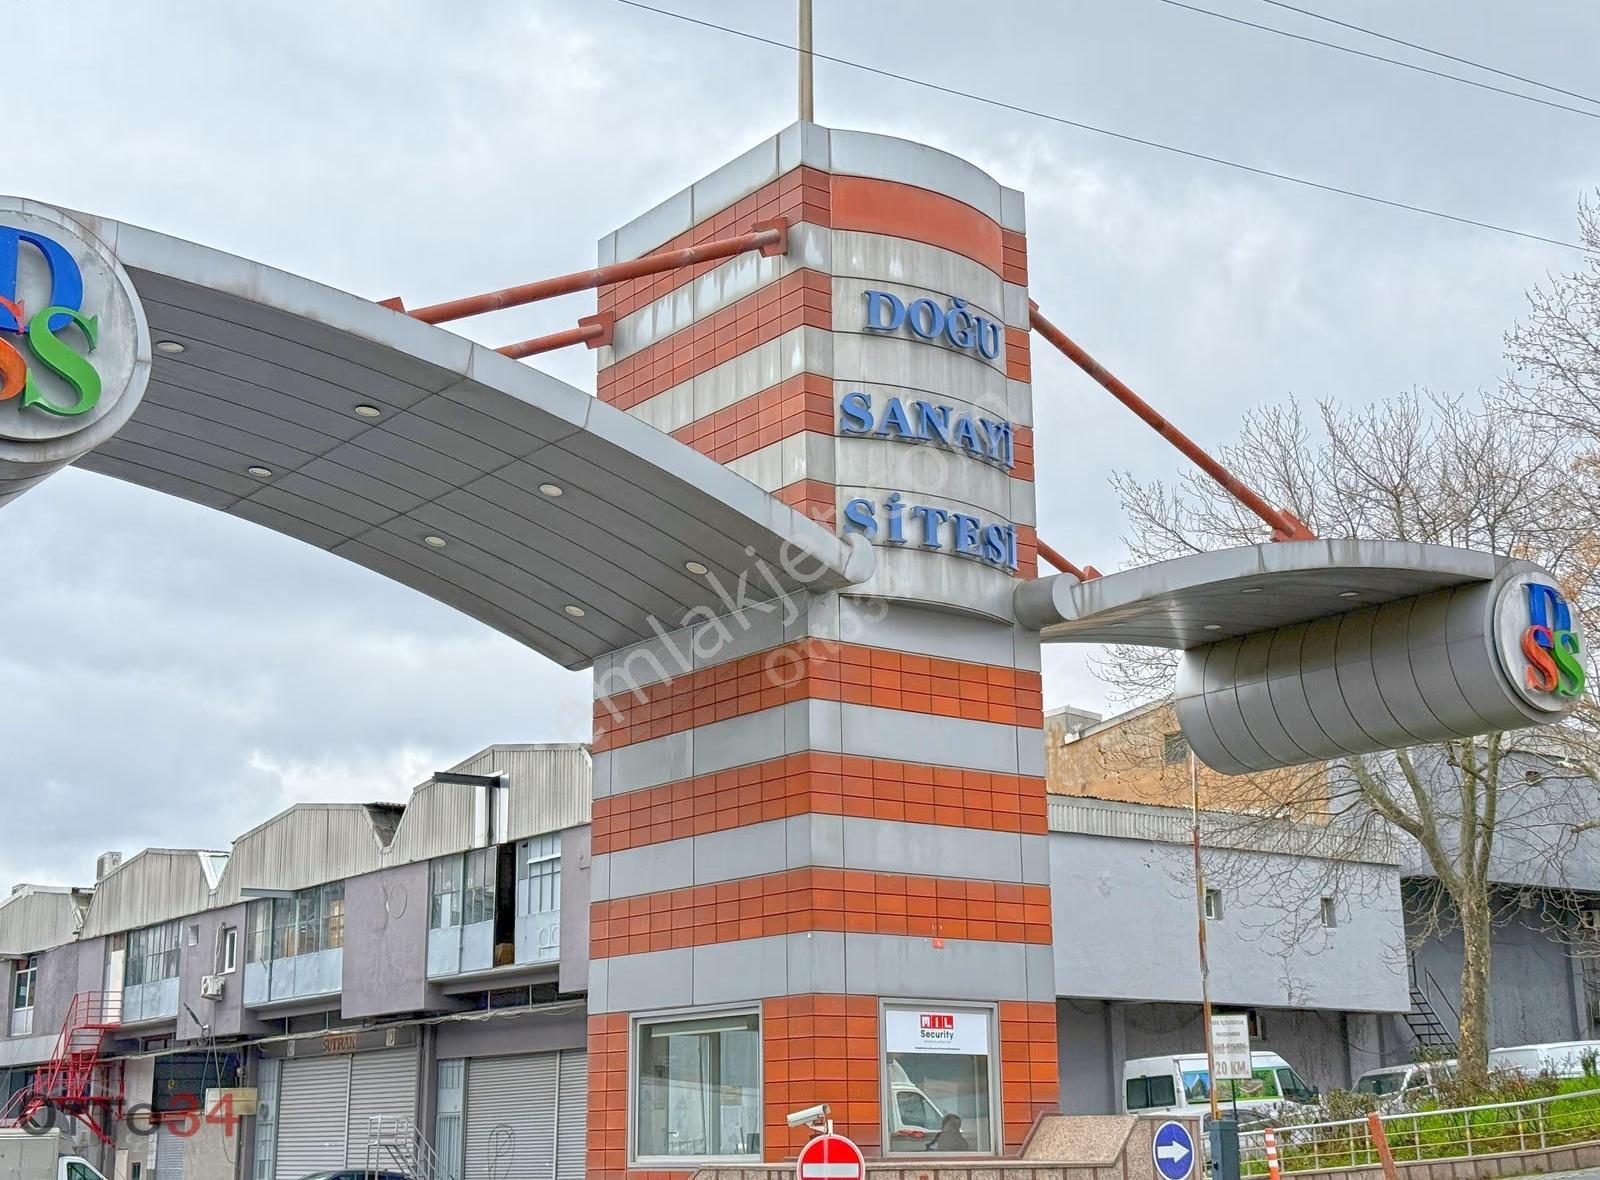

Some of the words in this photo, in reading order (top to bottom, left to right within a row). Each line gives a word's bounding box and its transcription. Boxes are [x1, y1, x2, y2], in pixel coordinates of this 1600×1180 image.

[864, 289, 1001, 360] DOĞU
[840, 391, 1016, 470] SANAYİ
[843, 491, 1020, 572] SİTESİ
[920, 1029, 955, 1040] Security
[1215, 1061, 1227, 1075] 20
